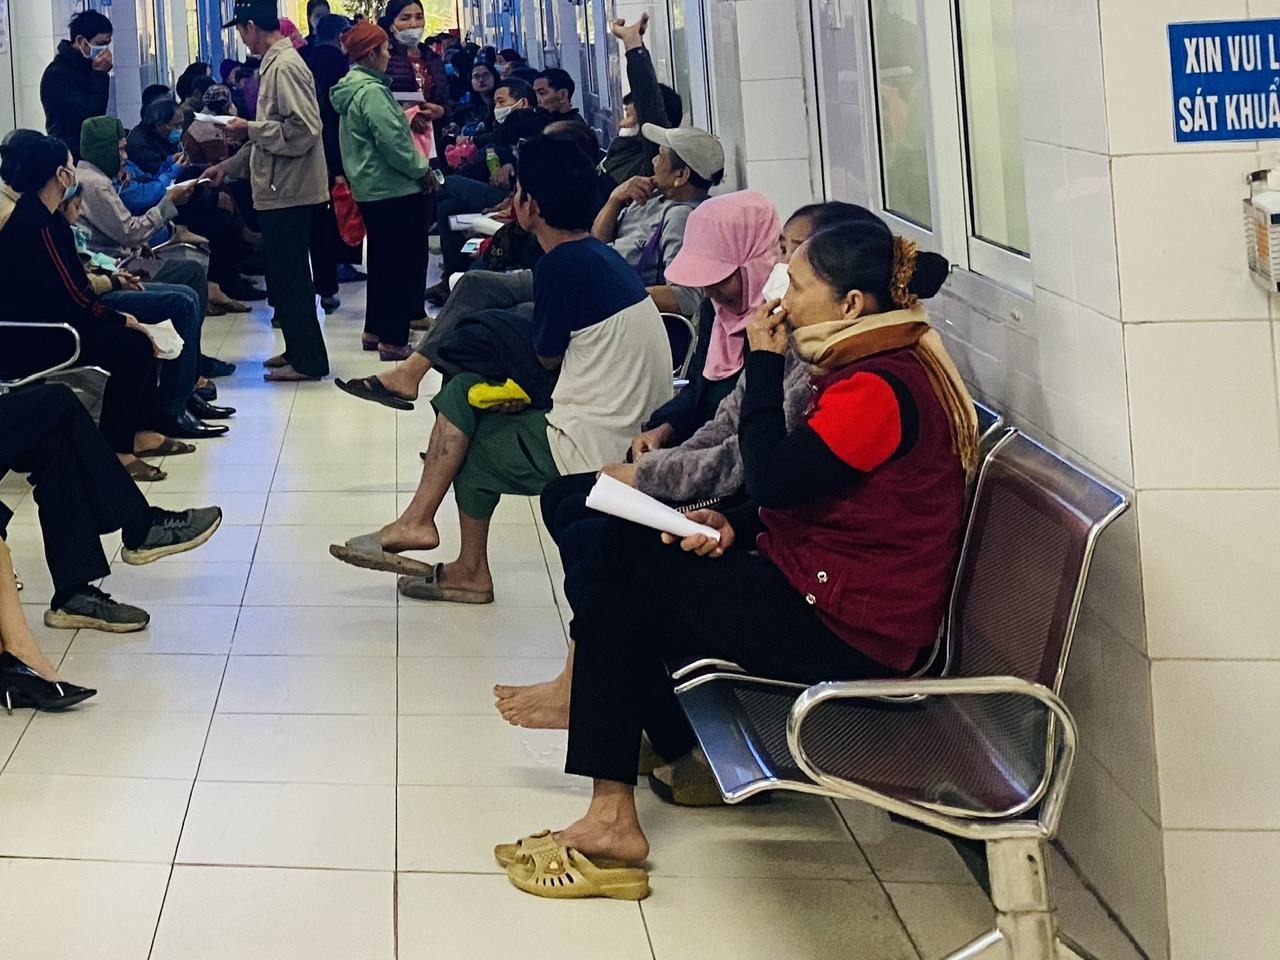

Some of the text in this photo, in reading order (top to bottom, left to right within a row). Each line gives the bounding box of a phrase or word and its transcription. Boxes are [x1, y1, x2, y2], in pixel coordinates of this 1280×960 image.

[1184, 36, 1222, 74] XIN
[1227, 34, 1262, 72] VUI
[1178, 87, 1218, 133] SÁT
